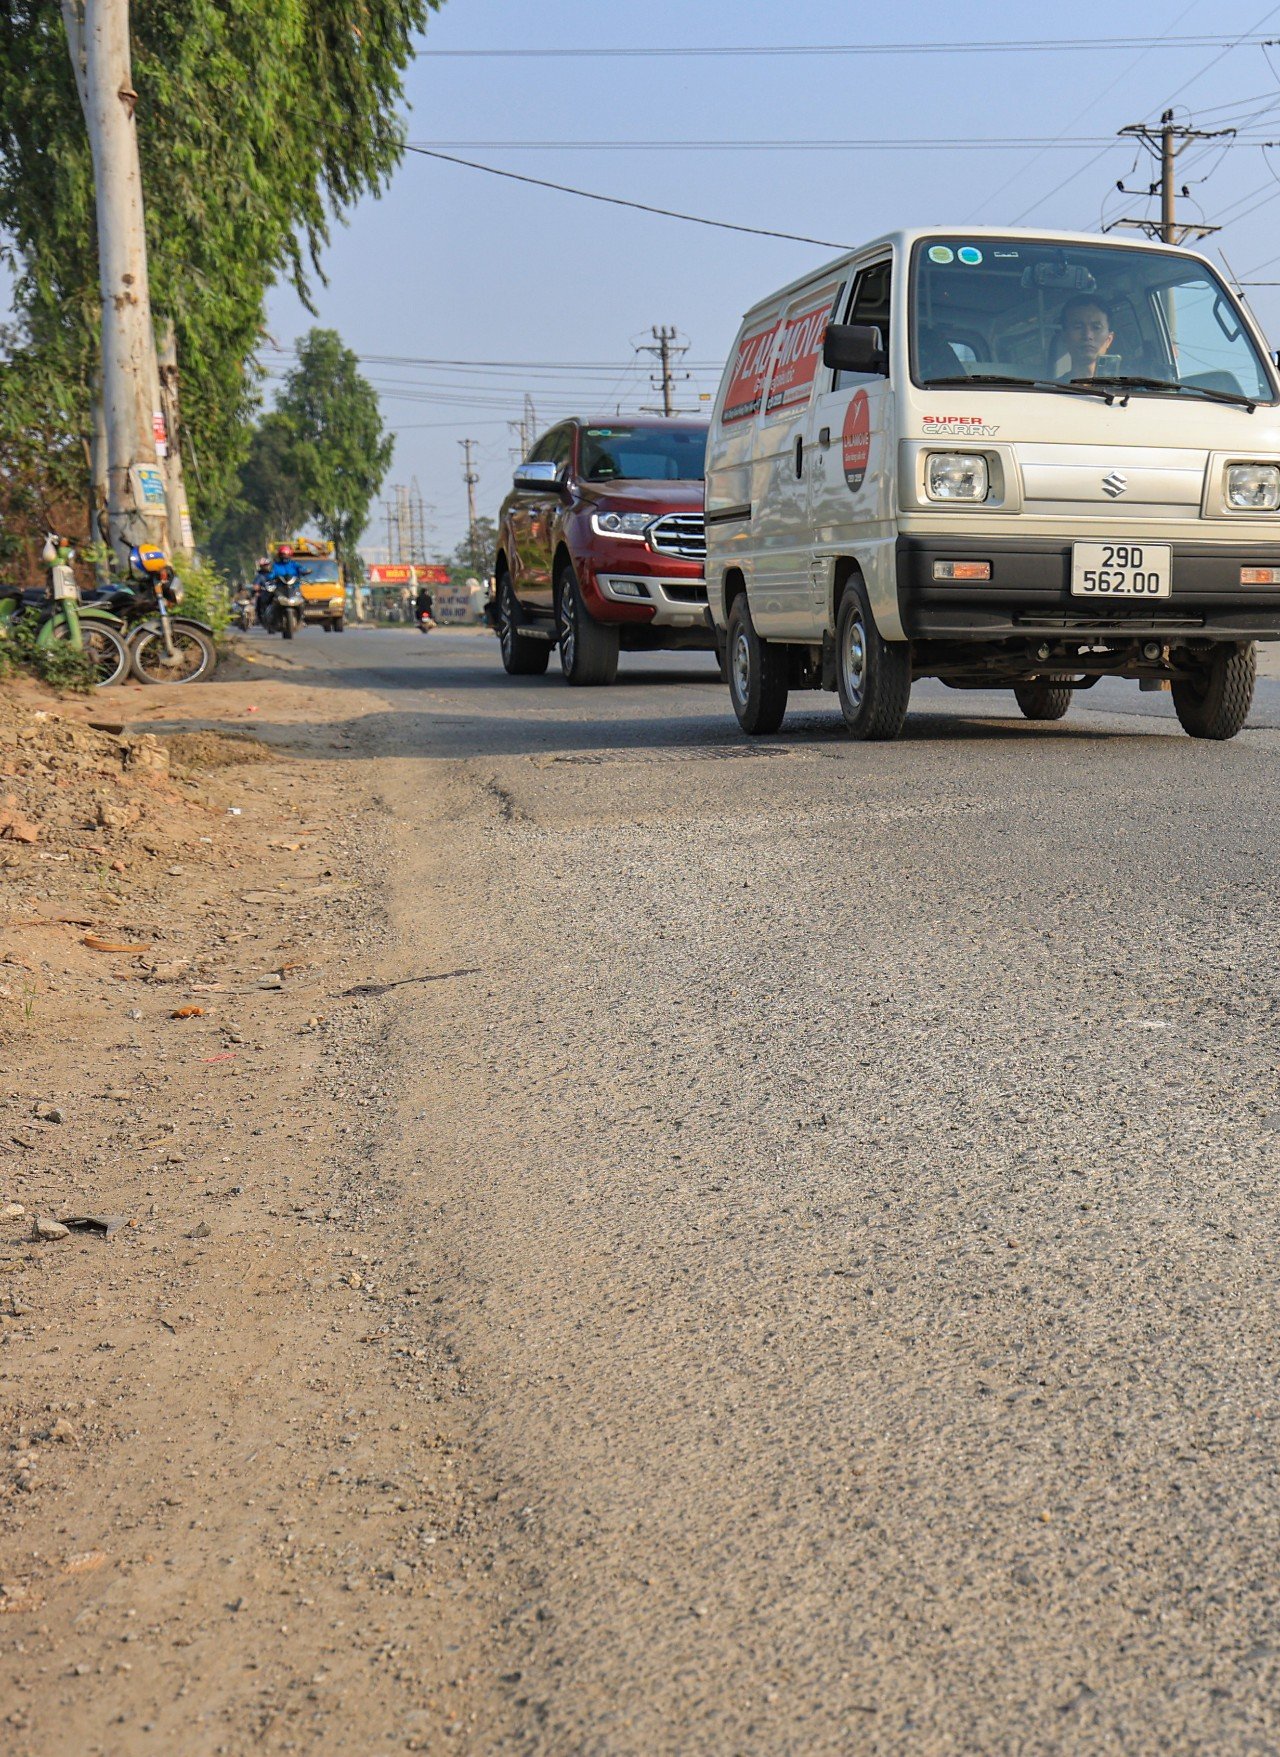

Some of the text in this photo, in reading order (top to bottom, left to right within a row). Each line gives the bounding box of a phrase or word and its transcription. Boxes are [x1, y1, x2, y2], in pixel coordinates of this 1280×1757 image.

[922, 416, 982, 424] SUPER
[922, 424, 1000, 436] CARRY
[1102, 546, 1143, 568] 29D
[1083, 571, 1159, 593] 562.00
